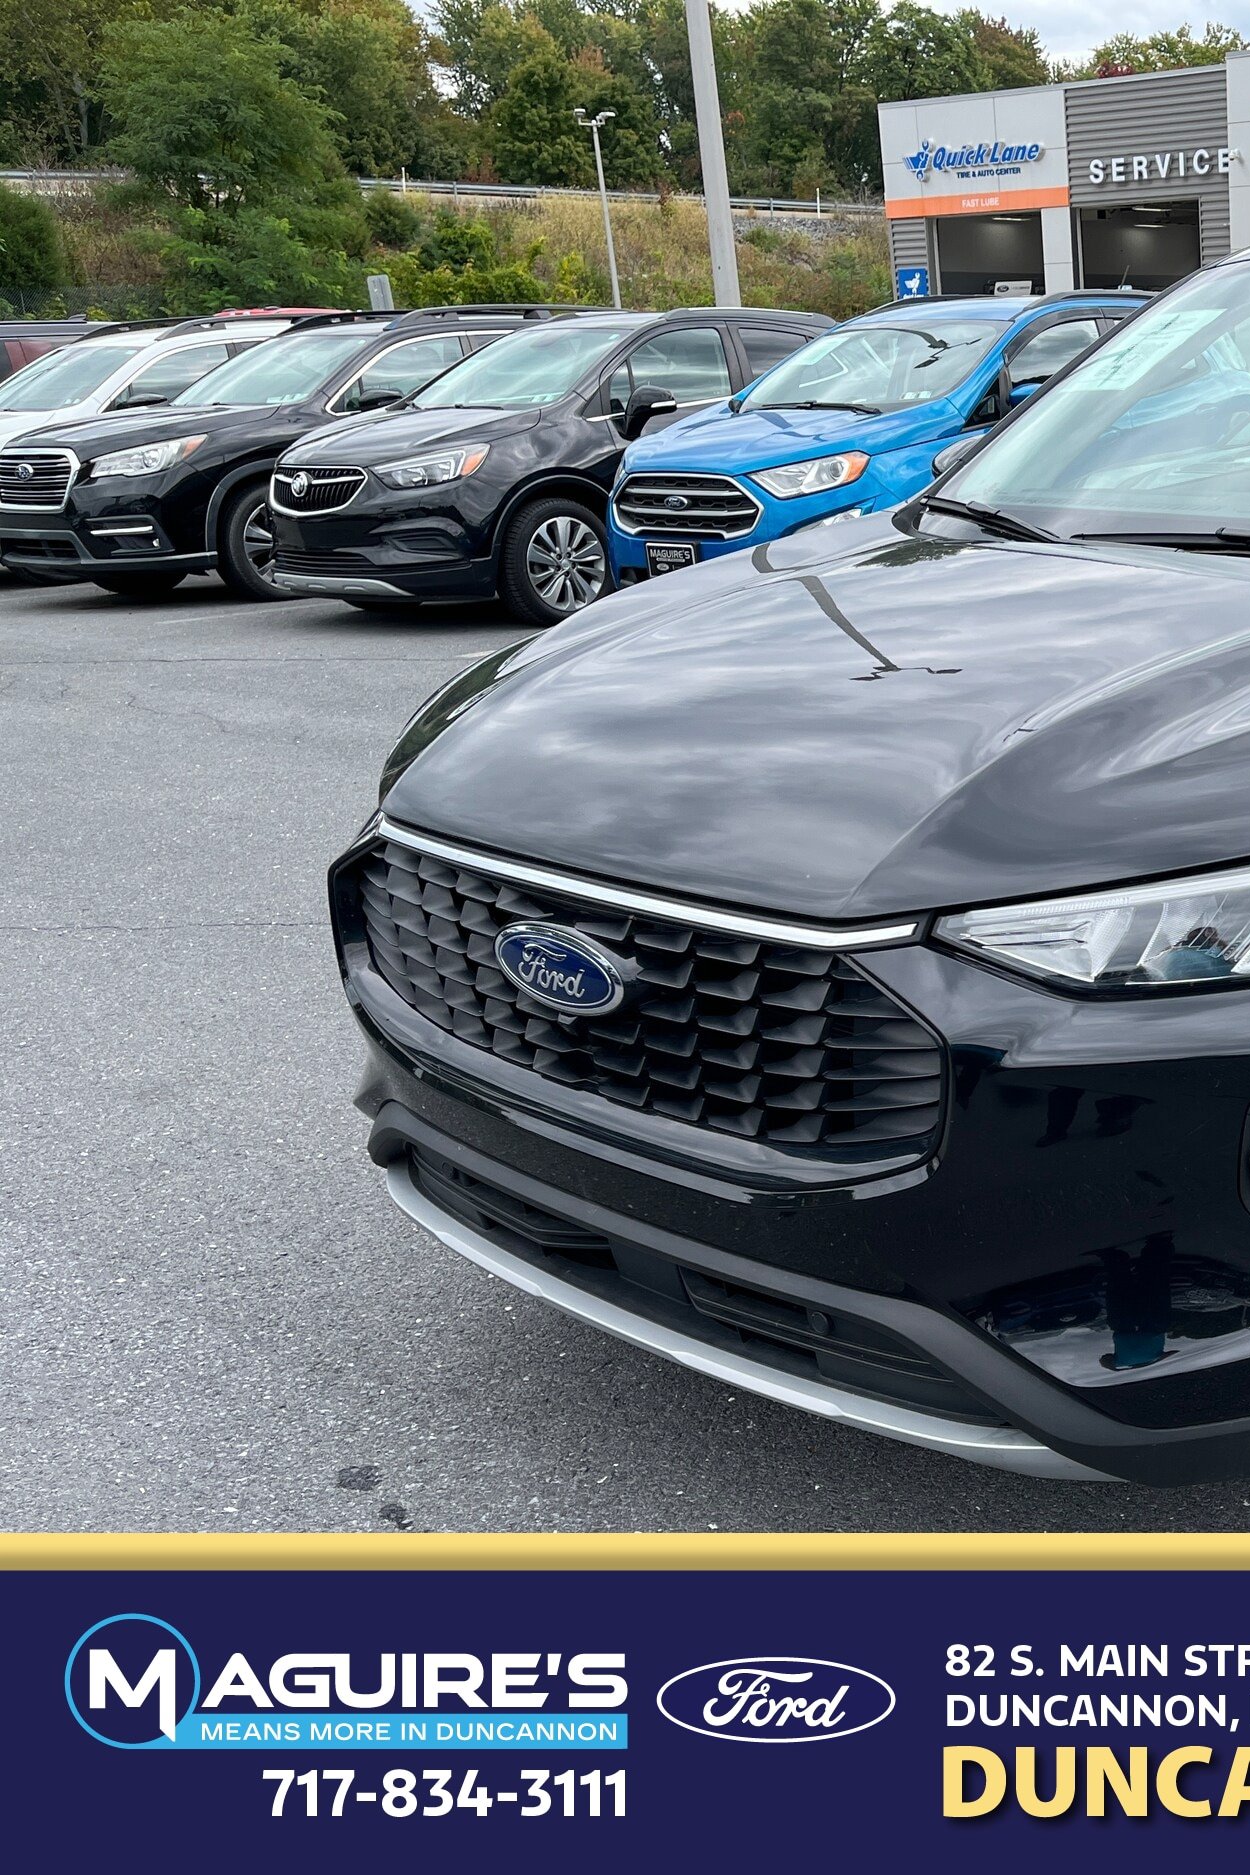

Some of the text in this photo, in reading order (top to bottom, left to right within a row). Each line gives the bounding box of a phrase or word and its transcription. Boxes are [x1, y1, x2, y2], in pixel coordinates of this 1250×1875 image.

[932, 141, 1041, 170] Quick Lane
[956, 170, 971, 179] TIRE
[977, 169, 995, 178] AUTO
[995, 166, 1021, 176] CENTER
[1088, 148, 1230, 185] SERVICE
[961, 196, 1000, 208] FAST LUBE
[650, 548, 692, 560] MAGUIRE'S
[517, 943, 586, 998] Ford
